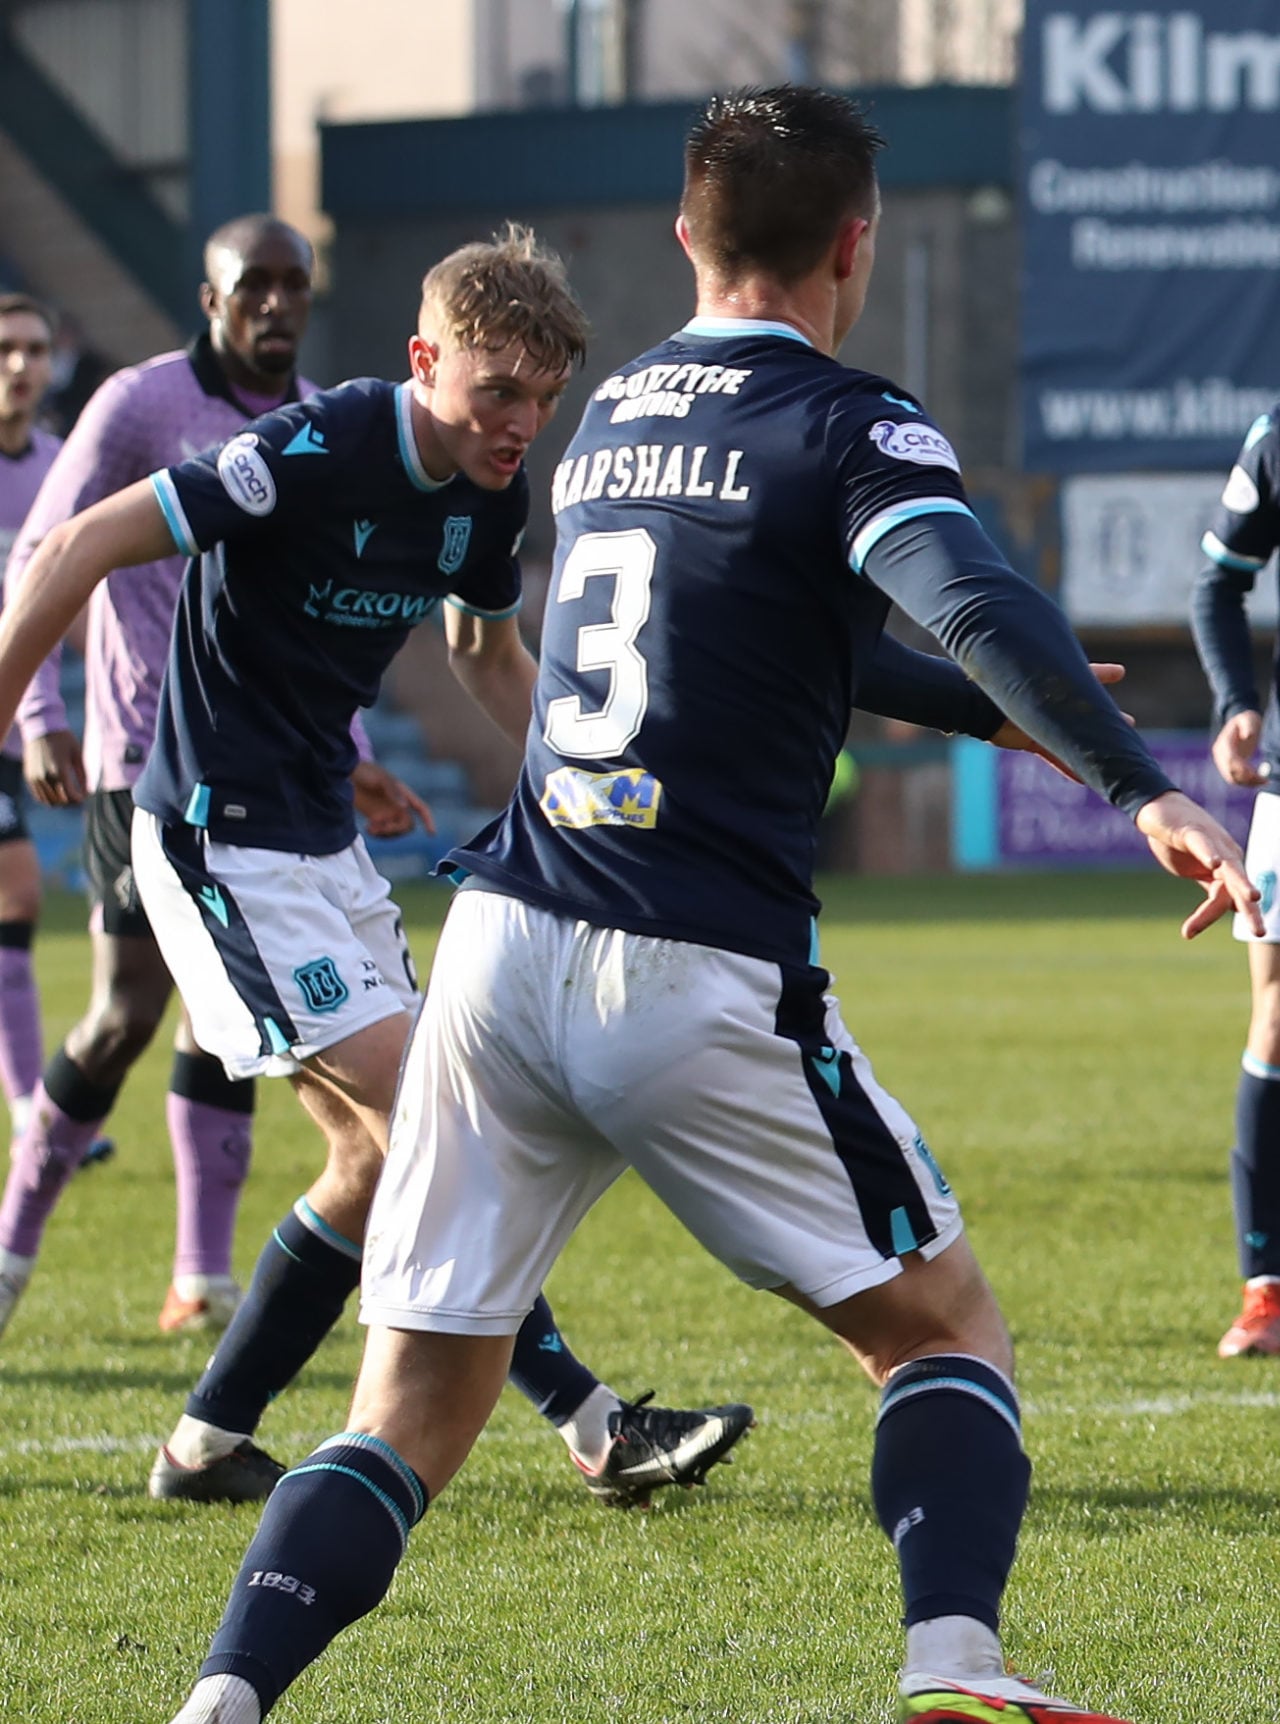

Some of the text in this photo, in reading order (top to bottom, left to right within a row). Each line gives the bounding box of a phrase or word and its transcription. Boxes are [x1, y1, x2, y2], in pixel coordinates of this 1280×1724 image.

[1031, 159, 1276, 213] Construction
[542, 527, 657, 759] 3
[247, 1570, 318, 1606] 1893
